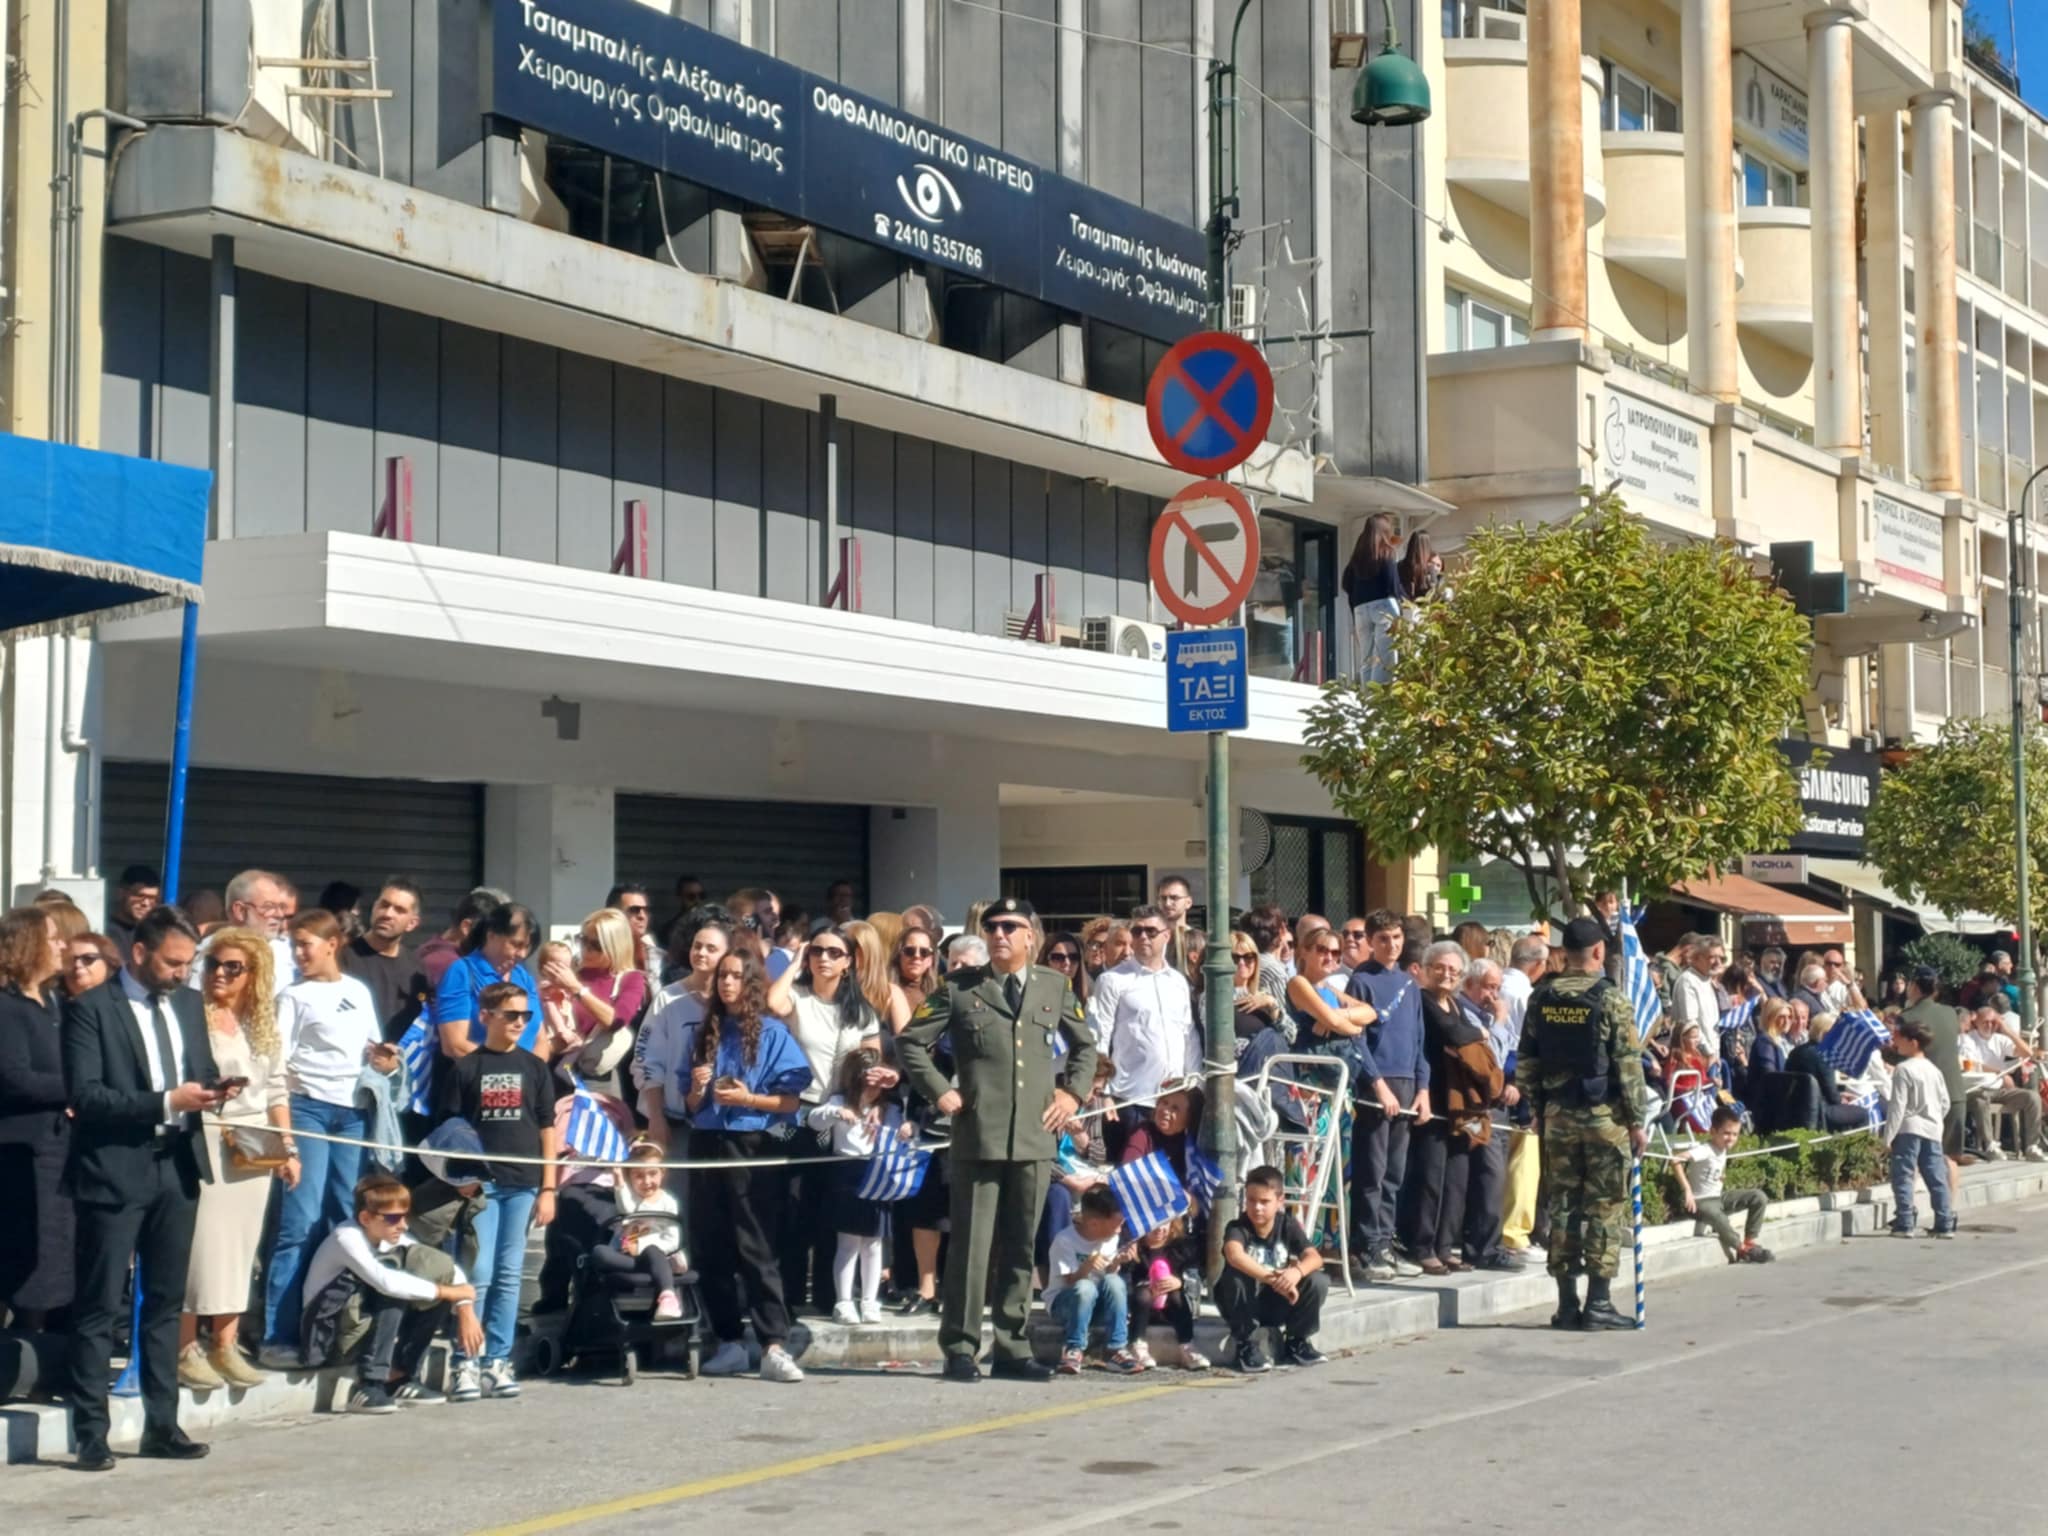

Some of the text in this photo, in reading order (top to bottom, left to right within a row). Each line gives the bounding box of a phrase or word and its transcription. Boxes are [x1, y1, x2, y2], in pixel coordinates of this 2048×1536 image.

[519, 0, 784, 131] Τσιαμπαλής Αλέξανδρος
[518, 43, 786, 173] Χειρουργός Οφθαλμίατρος
[812, 85, 1035, 193] ΟΦΘΑΛΜΟΛΟΓΙΚΟ ΙΑΤΡΕΙΟ
[893, 220, 983, 270] 2410 535766
[1069, 212, 1208, 291] Τσιαμπαλής Ιωάννης
[1055, 245, 1207, 322] Χειρουργός Οφθαλμίατρ
[1178, 674, 1235, 701] ΤΑΞΙ
[1188, 707, 1228, 721] ΕΚΤΟΣ
[1801, 767, 1870, 808] SAMSUNG
[1751, 860, 1793, 869] NOKIA
[1541, 1006, 1591, 1016] MILITARY
[1545, 1014, 1586, 1024] POLICE
